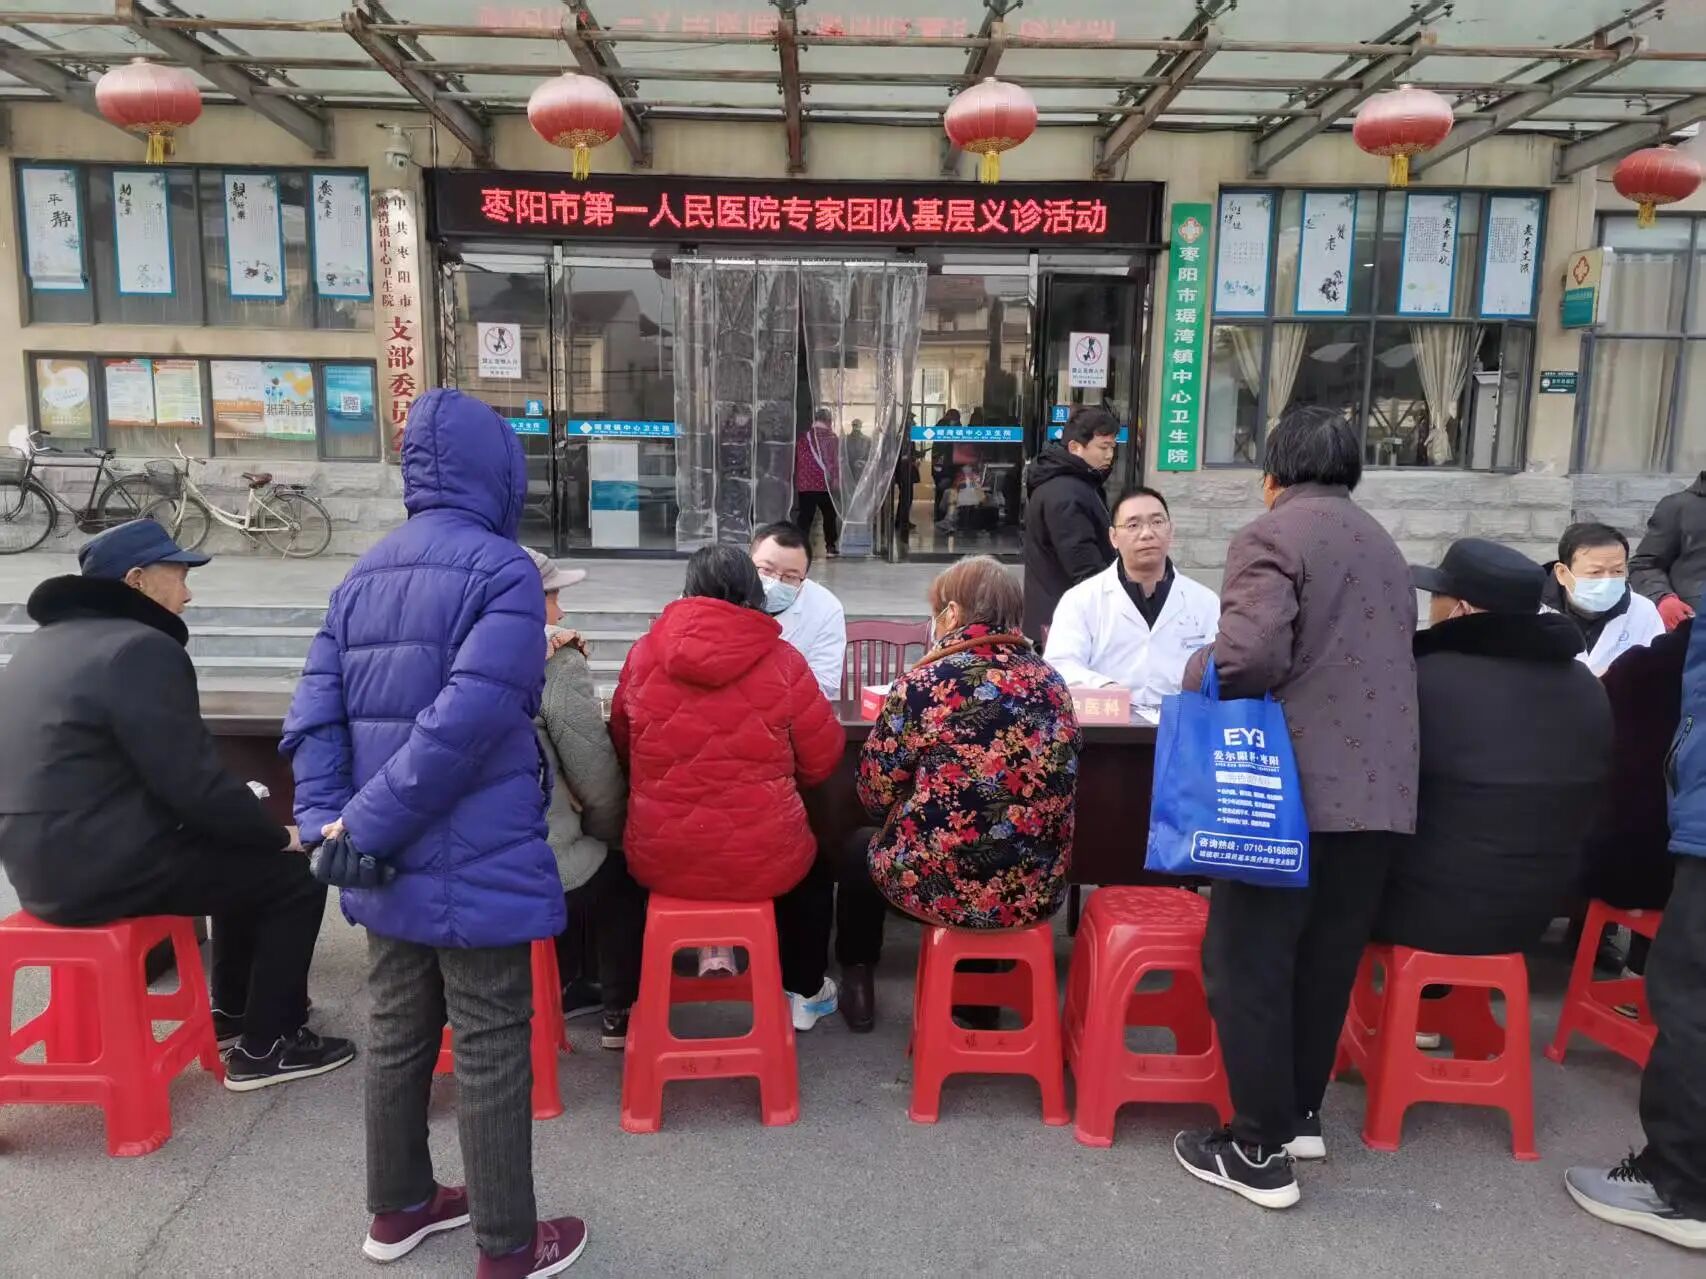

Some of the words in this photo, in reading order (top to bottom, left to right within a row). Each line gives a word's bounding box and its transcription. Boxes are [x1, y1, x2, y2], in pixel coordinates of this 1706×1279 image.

[394, 197, 412, 308] 中共枣阳市
[480, 187, 1107, 234] 枣阳市第一人民医院专家团队基层义诊活动
[1168, 246, 1200, 464] 枣阳市琚湾镇中心卫生院
